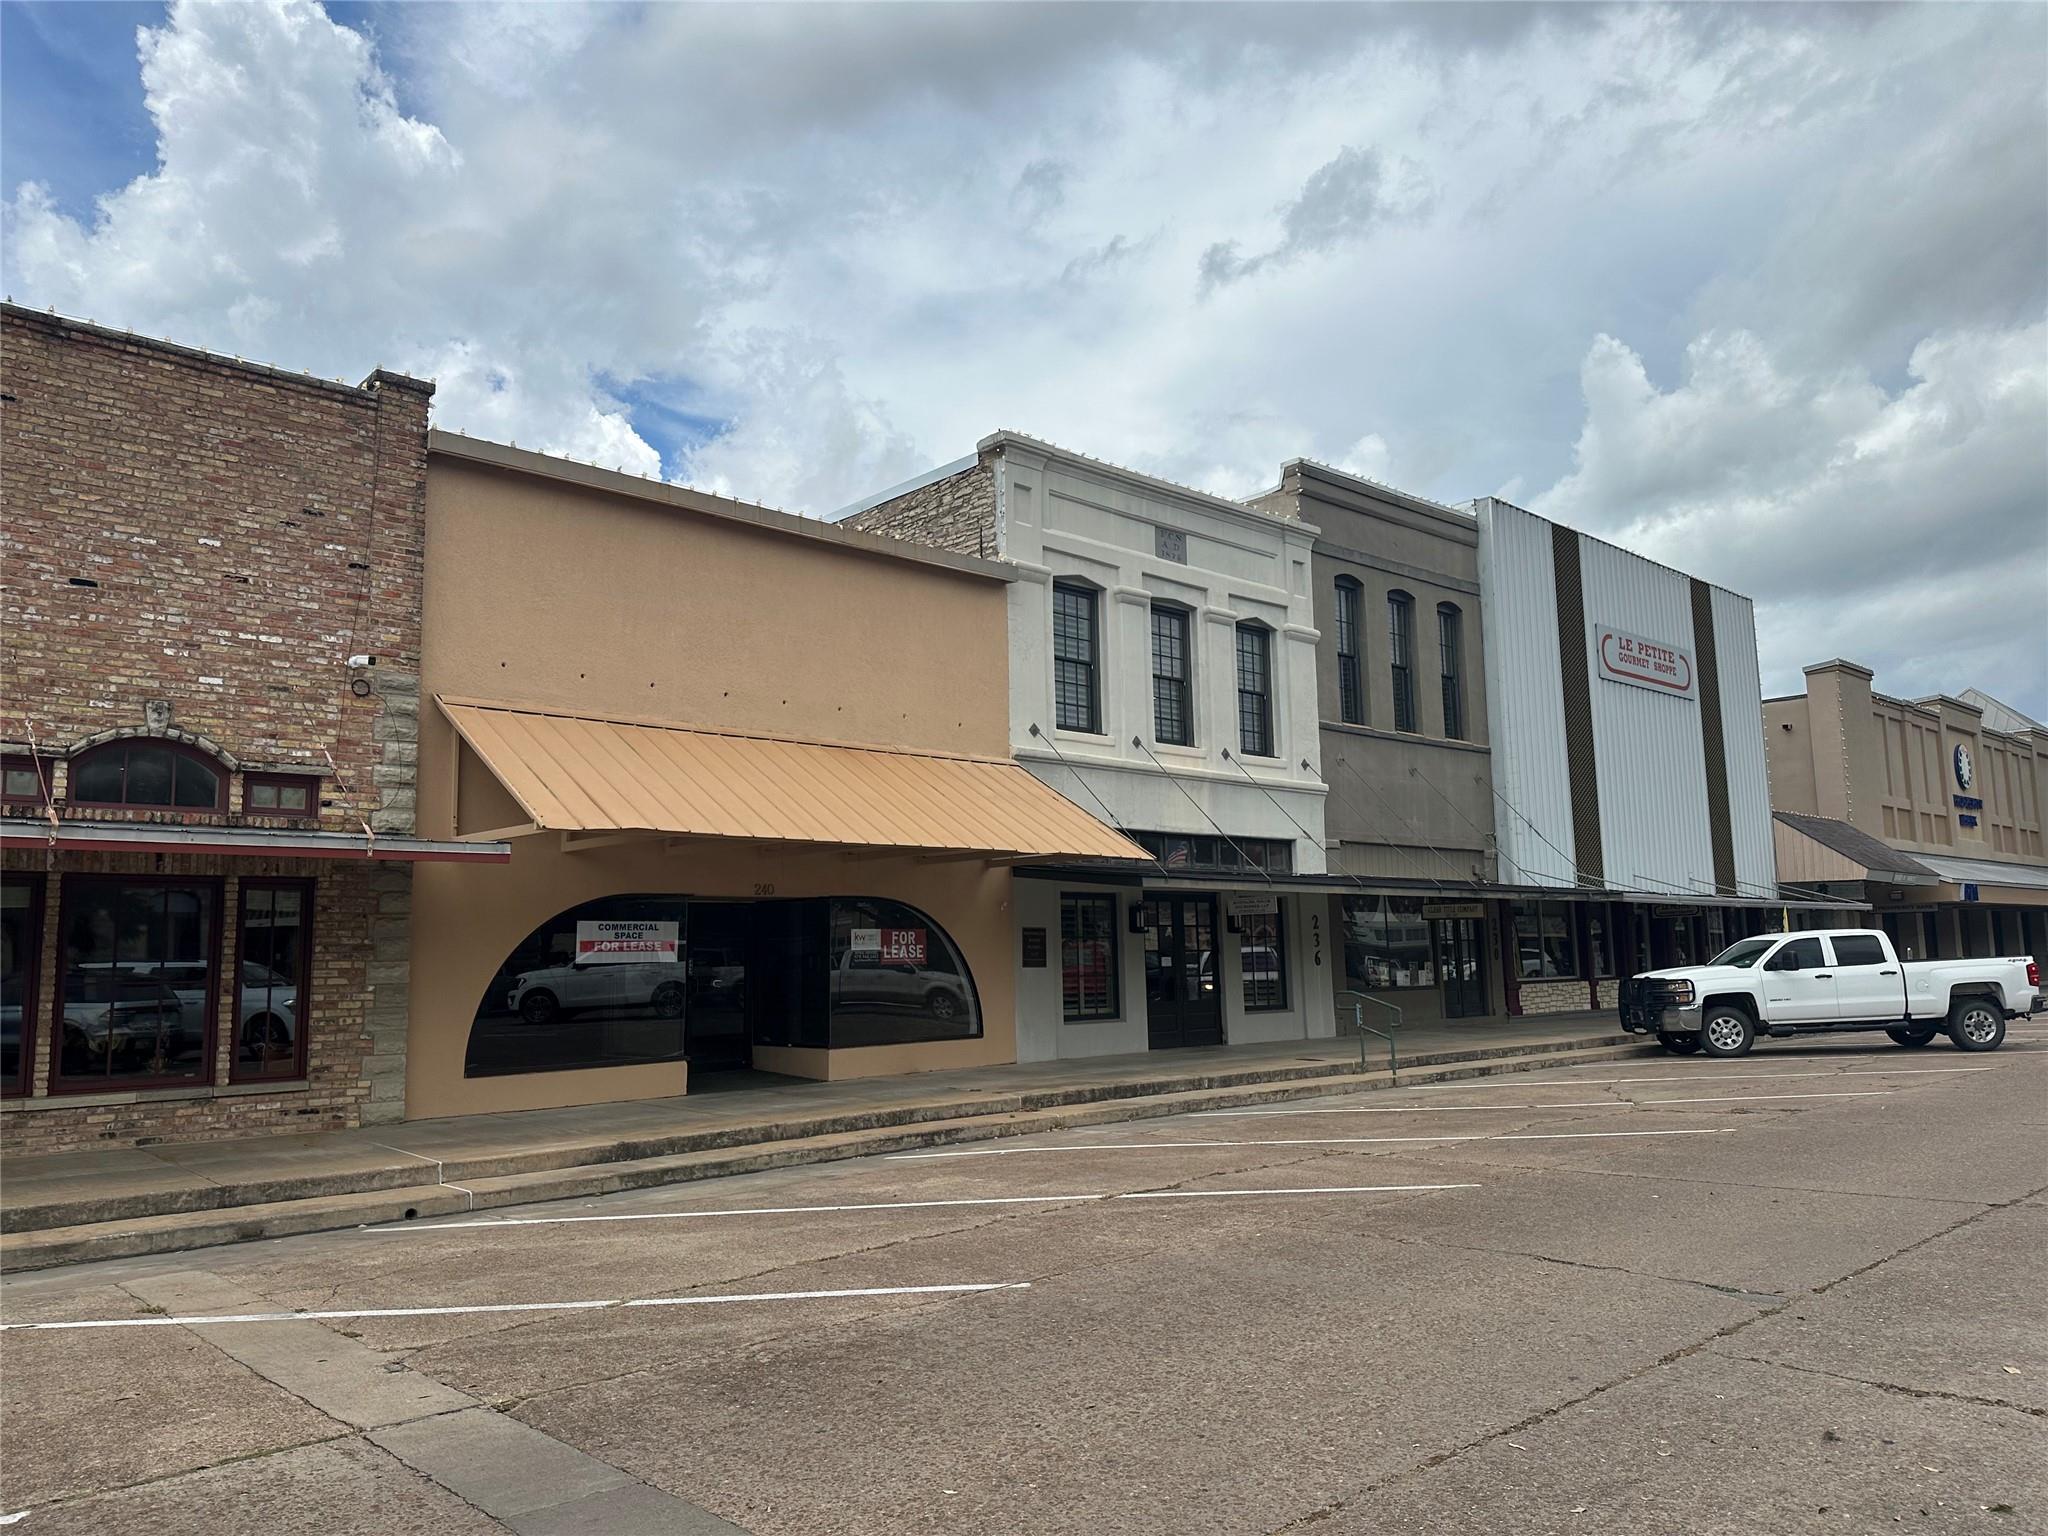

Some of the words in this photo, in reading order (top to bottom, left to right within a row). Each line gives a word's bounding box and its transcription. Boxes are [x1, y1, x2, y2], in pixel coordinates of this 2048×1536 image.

[1618, 636, 1633, 652] LE
[1637, 641, 1675, 664] PETITE
[1618, 652, 1650, 669] GOURMET
[1653, 661, 1677, 676] SHOPPE
[754, 883, 775, 896] 240
[598, 923, 659, 931] COMMERCIAL
[614, 931, 644, 939] SPACE
[854, 932, 866, 942] kw
[891, 931, 916, 945] FOR
[1311, 914, 1321, 967] 236
[594, 941, 620, 952] FOR
[623, 941, 662, 951] LEASE
[883, 944, 924, 958] LEASE
